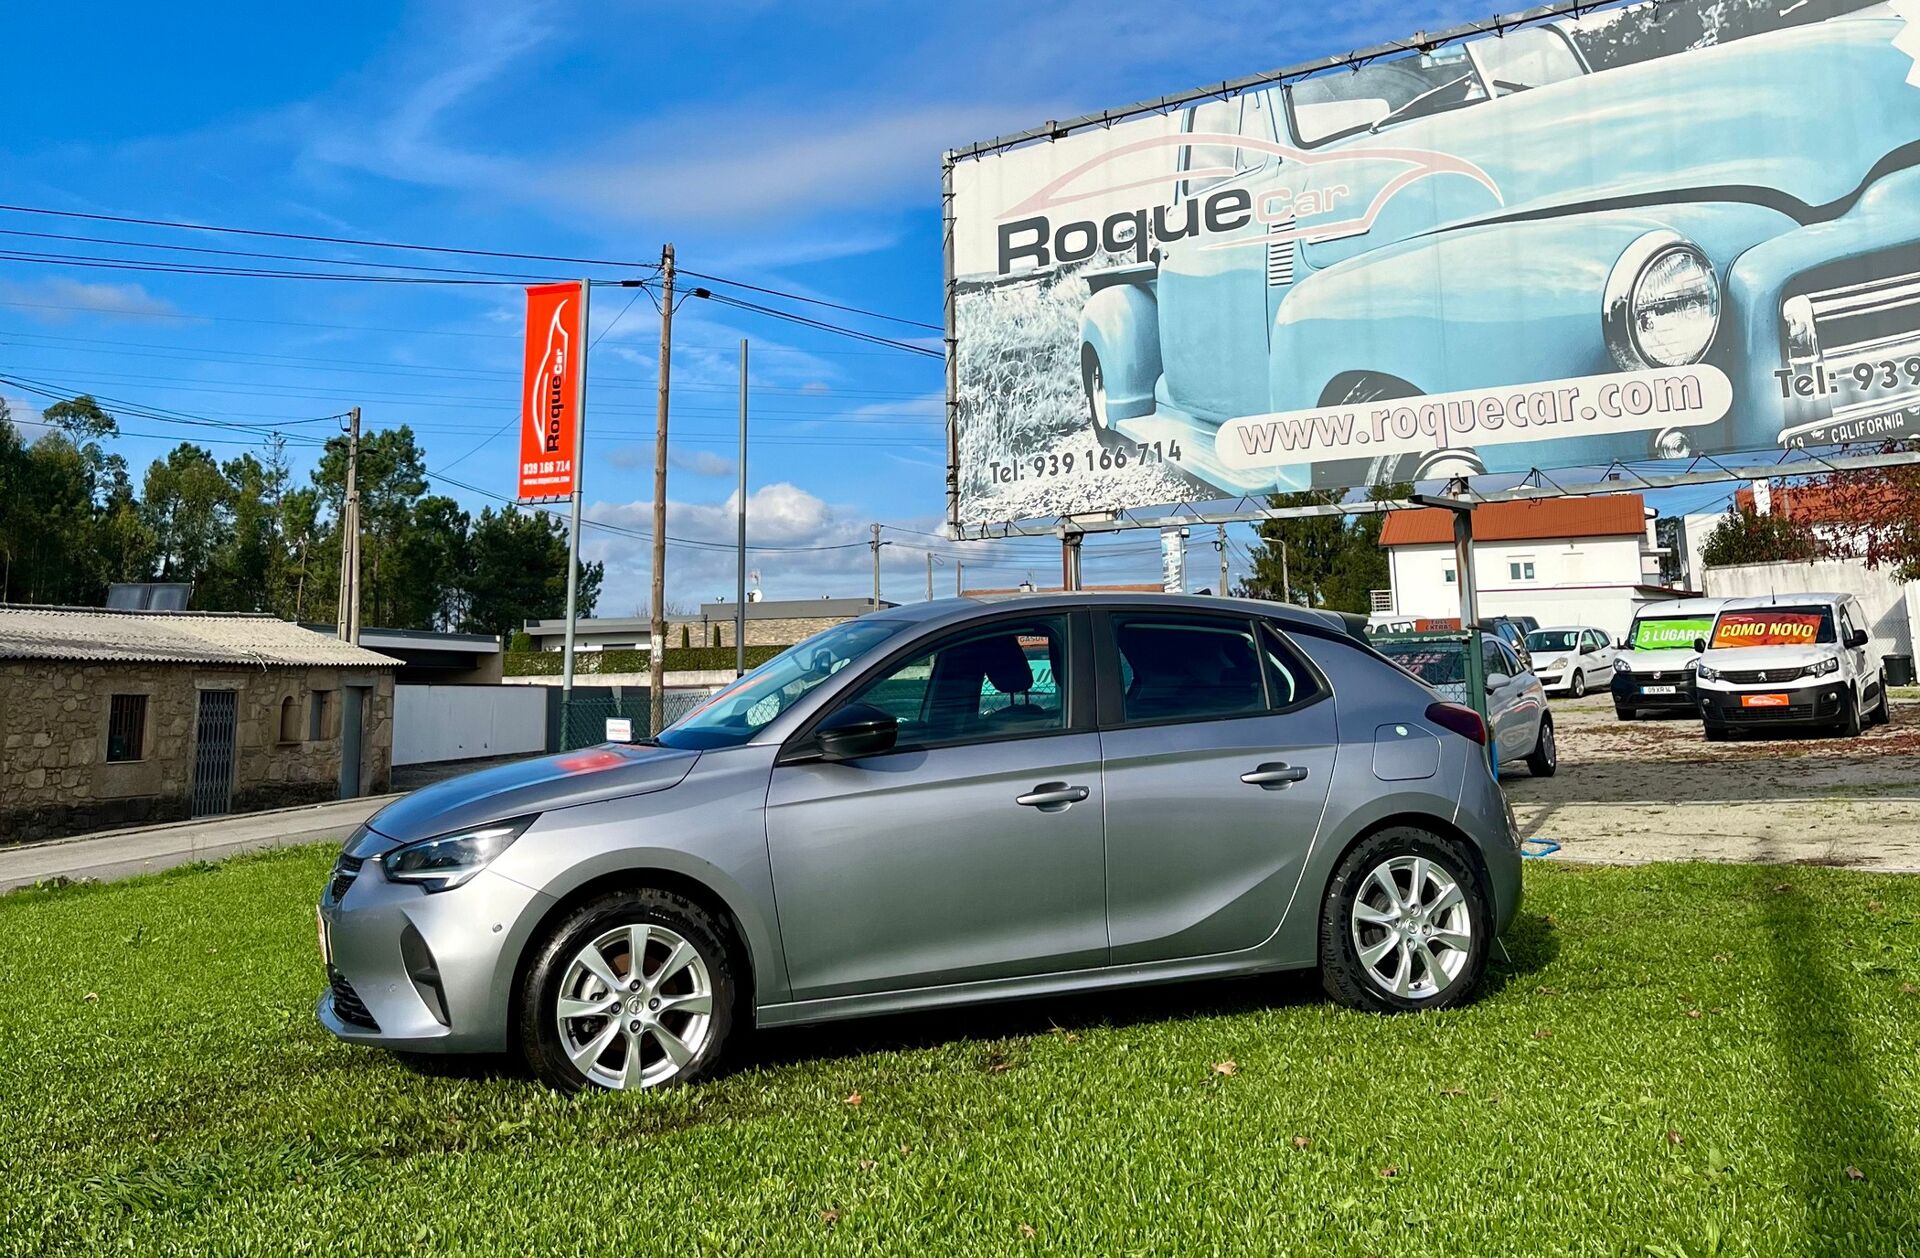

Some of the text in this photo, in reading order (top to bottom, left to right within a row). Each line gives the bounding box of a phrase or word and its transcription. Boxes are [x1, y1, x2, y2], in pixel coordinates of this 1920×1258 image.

[1774, 357, 1920, 398] Tel: 939
[1237, 374, 1703, 449] www.roquecar.com
[1831, 412, 1904, 443] CALIFORNIA
[523, 459, 571, 475] 939 166 714
[989, 439, 1182, 484] Tel: 939 166 714
[1642, 630, 1650, 642] 3
[1720, 622, 1814, 638] COMO NOVO
